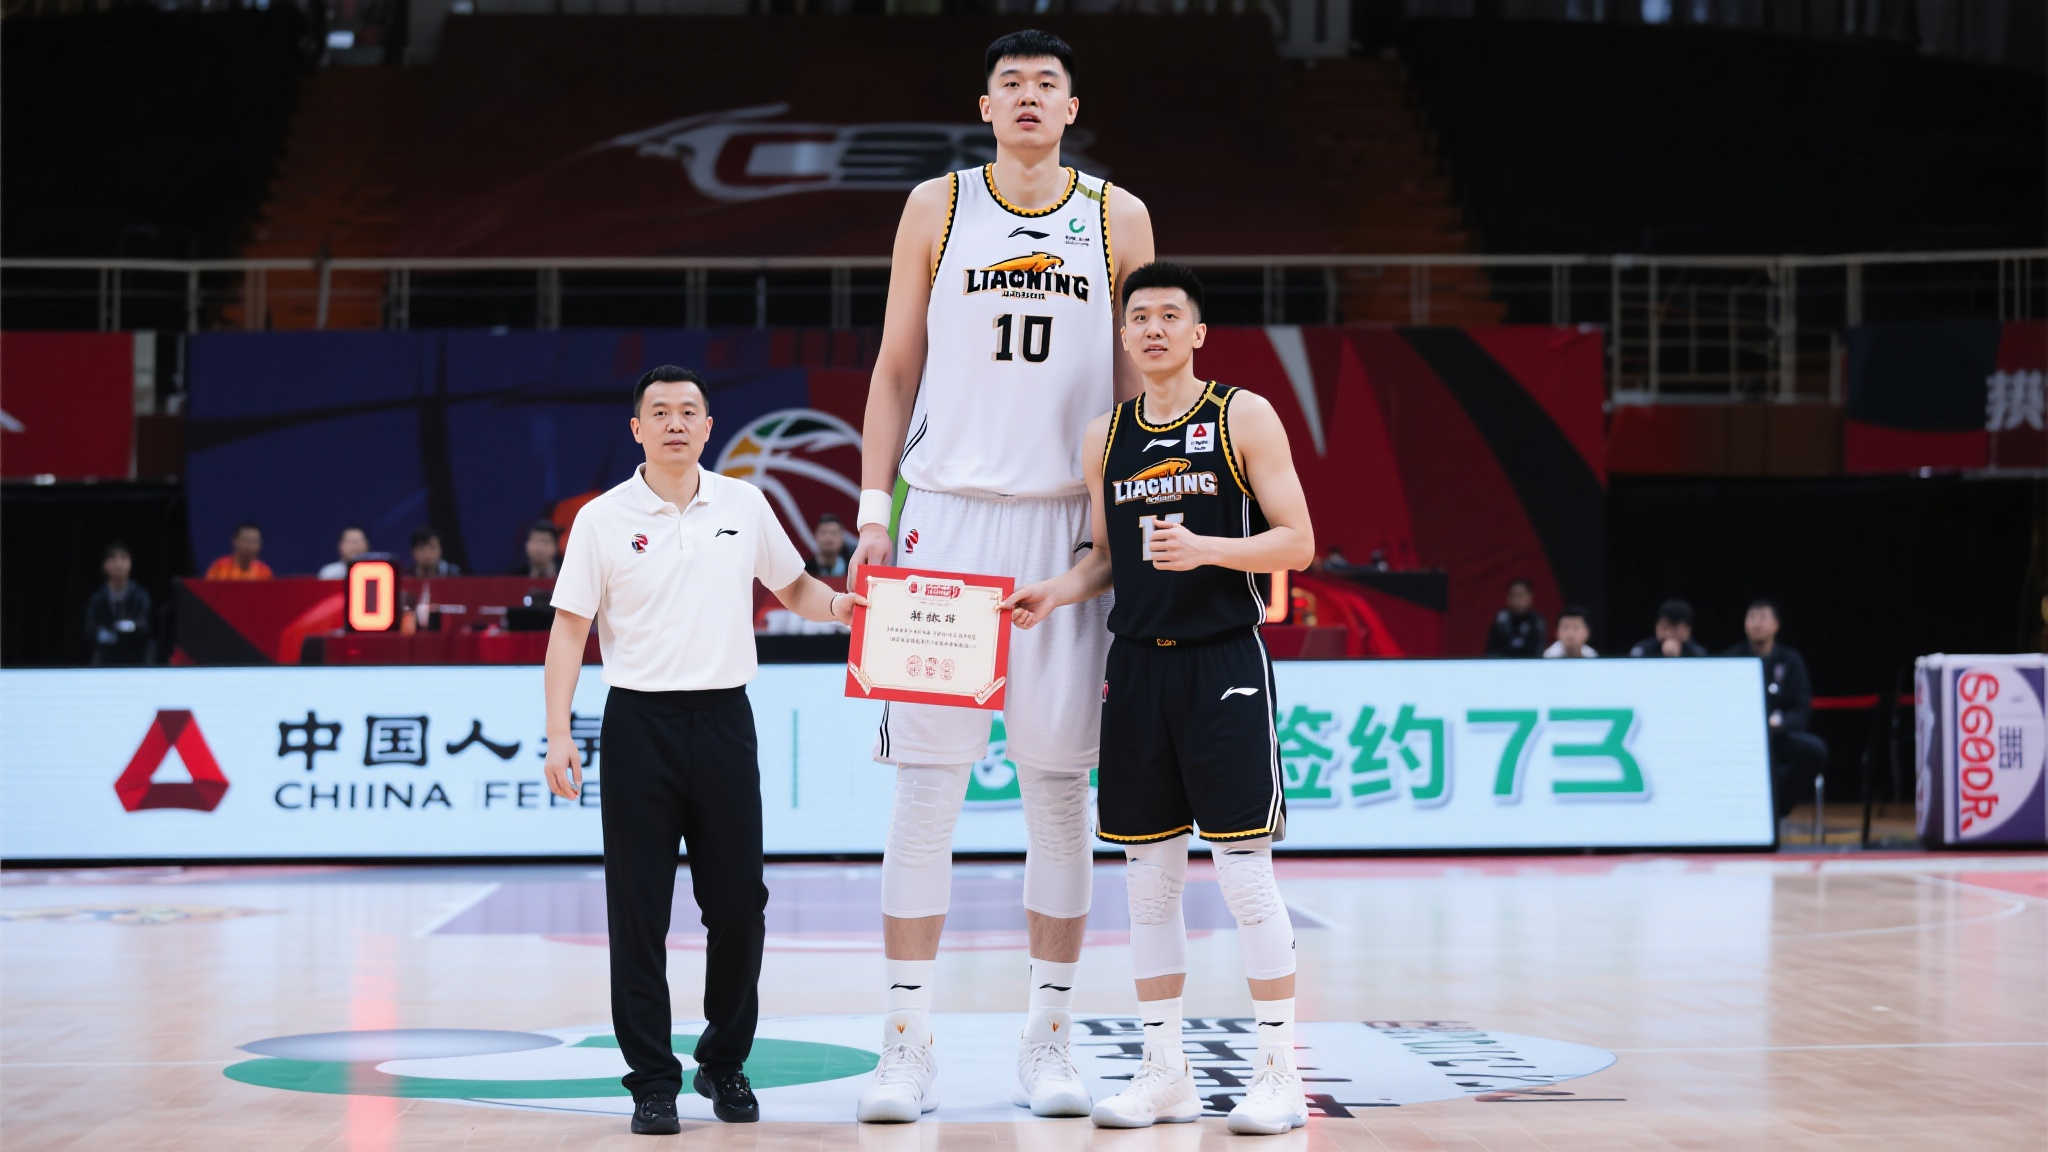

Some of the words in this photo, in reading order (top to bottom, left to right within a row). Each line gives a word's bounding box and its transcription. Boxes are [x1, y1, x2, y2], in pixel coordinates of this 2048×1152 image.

[994, 313, 1054, 363] 10
[1138, 512, 1185, 562] 1
[349, 561, 395, 632] 0
[275, 782, 451, 809] CHIINA
